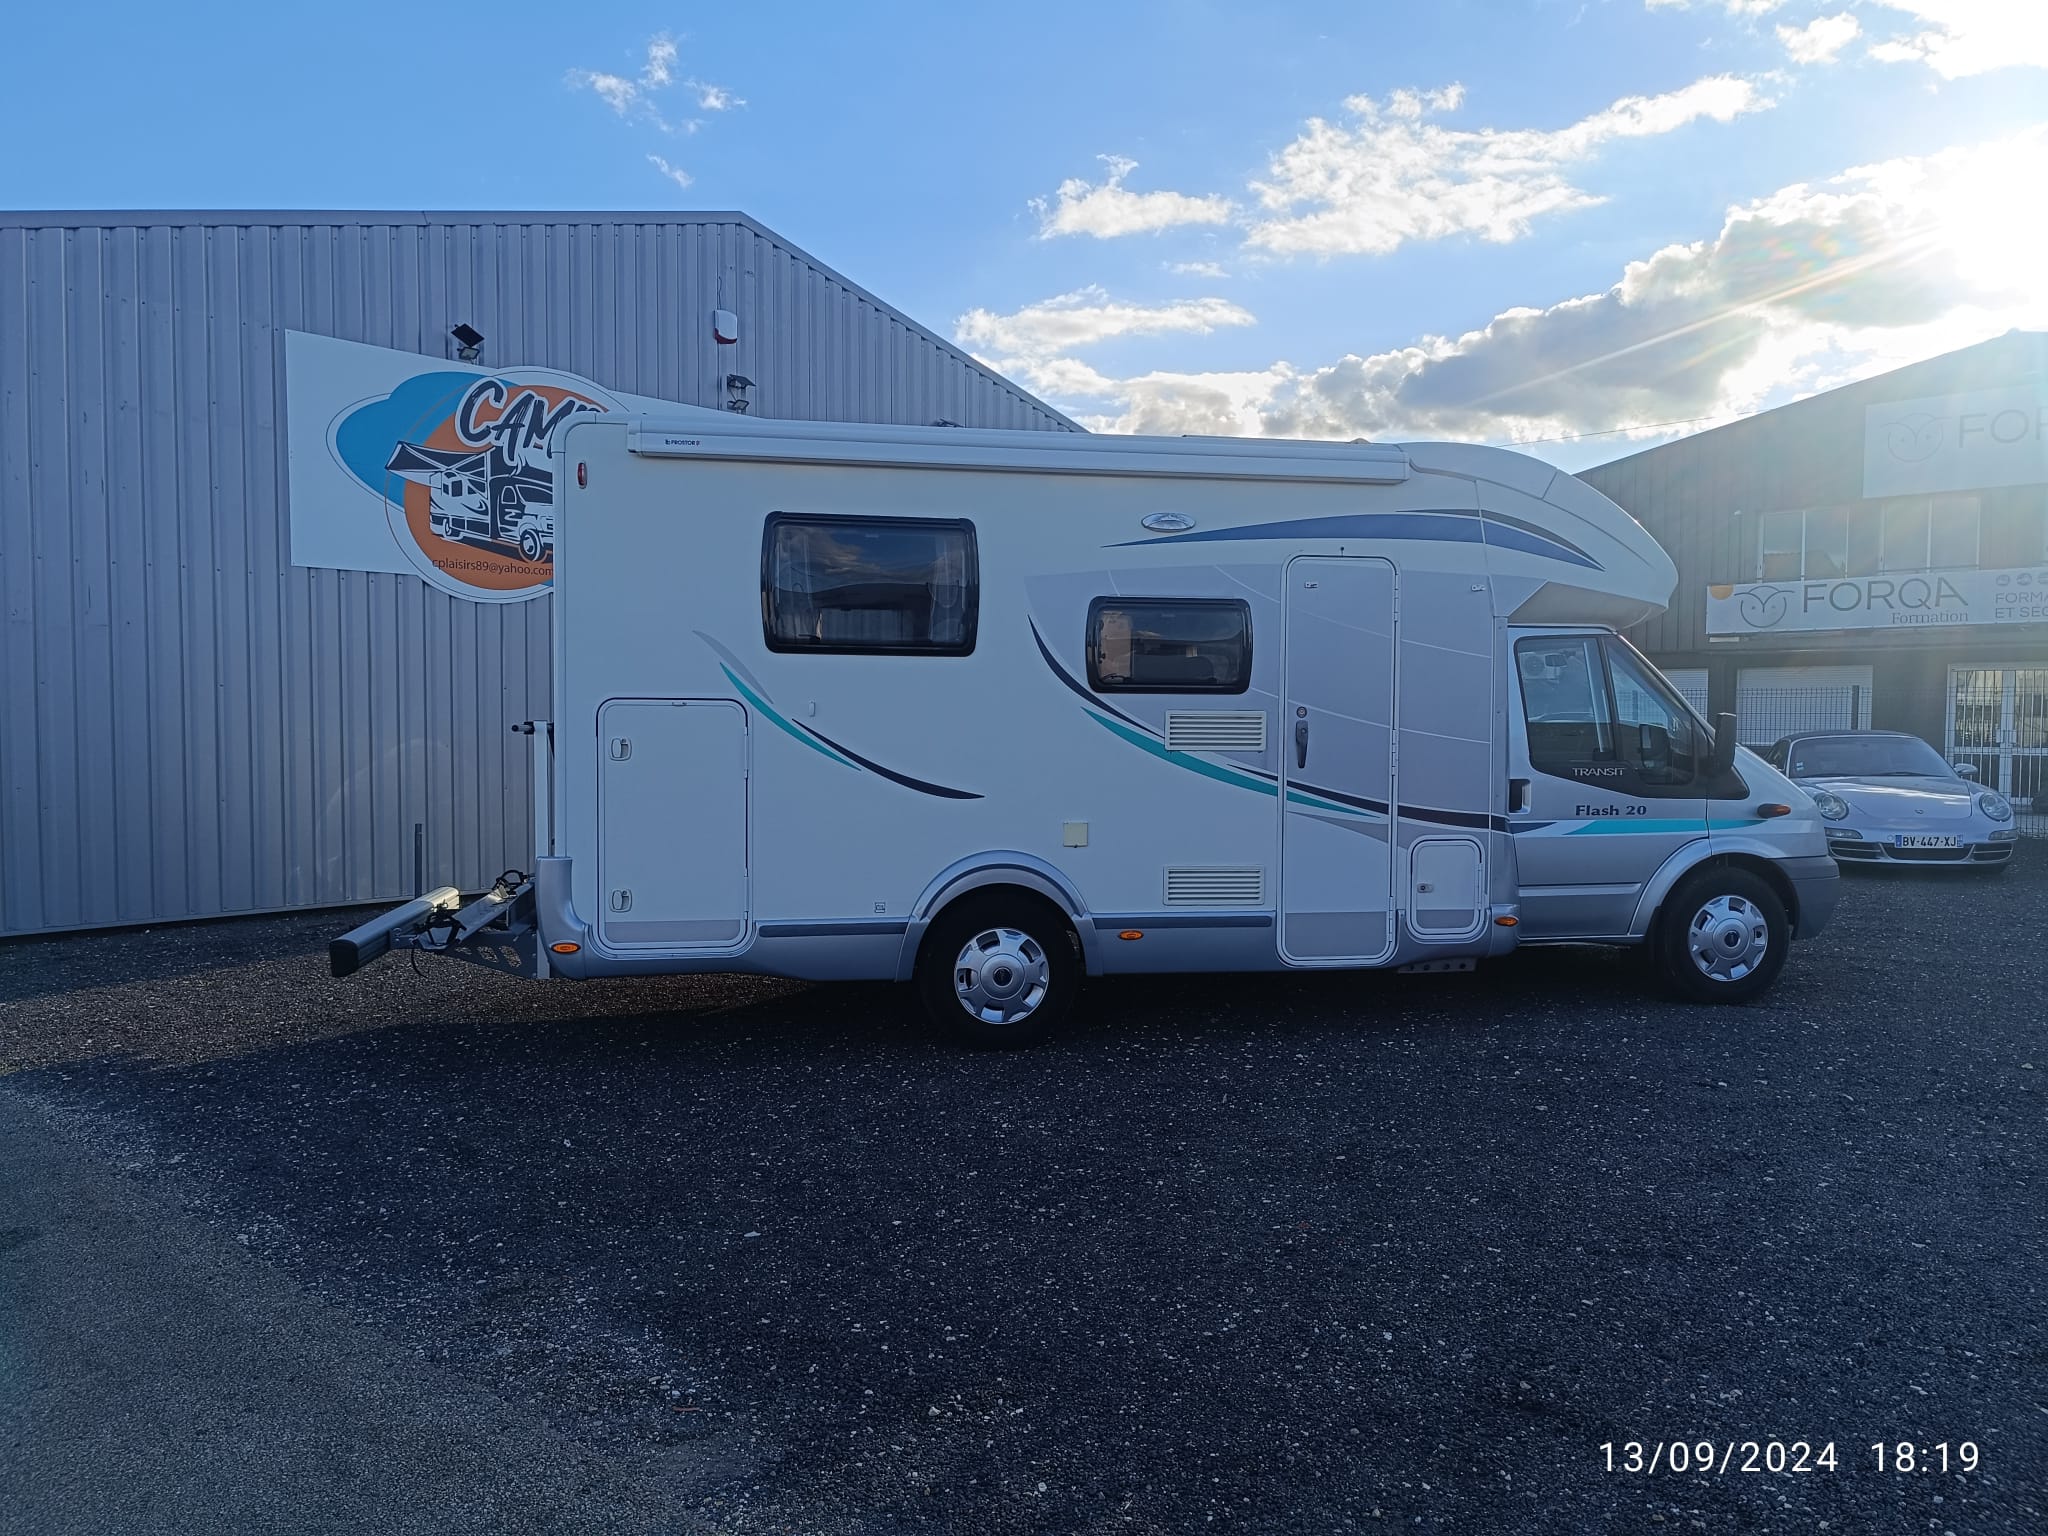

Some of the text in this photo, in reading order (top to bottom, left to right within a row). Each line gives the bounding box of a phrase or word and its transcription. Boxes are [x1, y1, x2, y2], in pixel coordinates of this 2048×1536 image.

[459, 380, 601, 462] CAM
[1803, 576, 1969, 613] FORQA
[1892, 611, 1969, 625] Formation
[1995, 608, 2015, 619] ET
[1572, 767, 1625, 777] TRANSIT
[1575, 804, 1647, 816] Flash 20
[1902, 836, 1957, 847] BV-447-XJ
